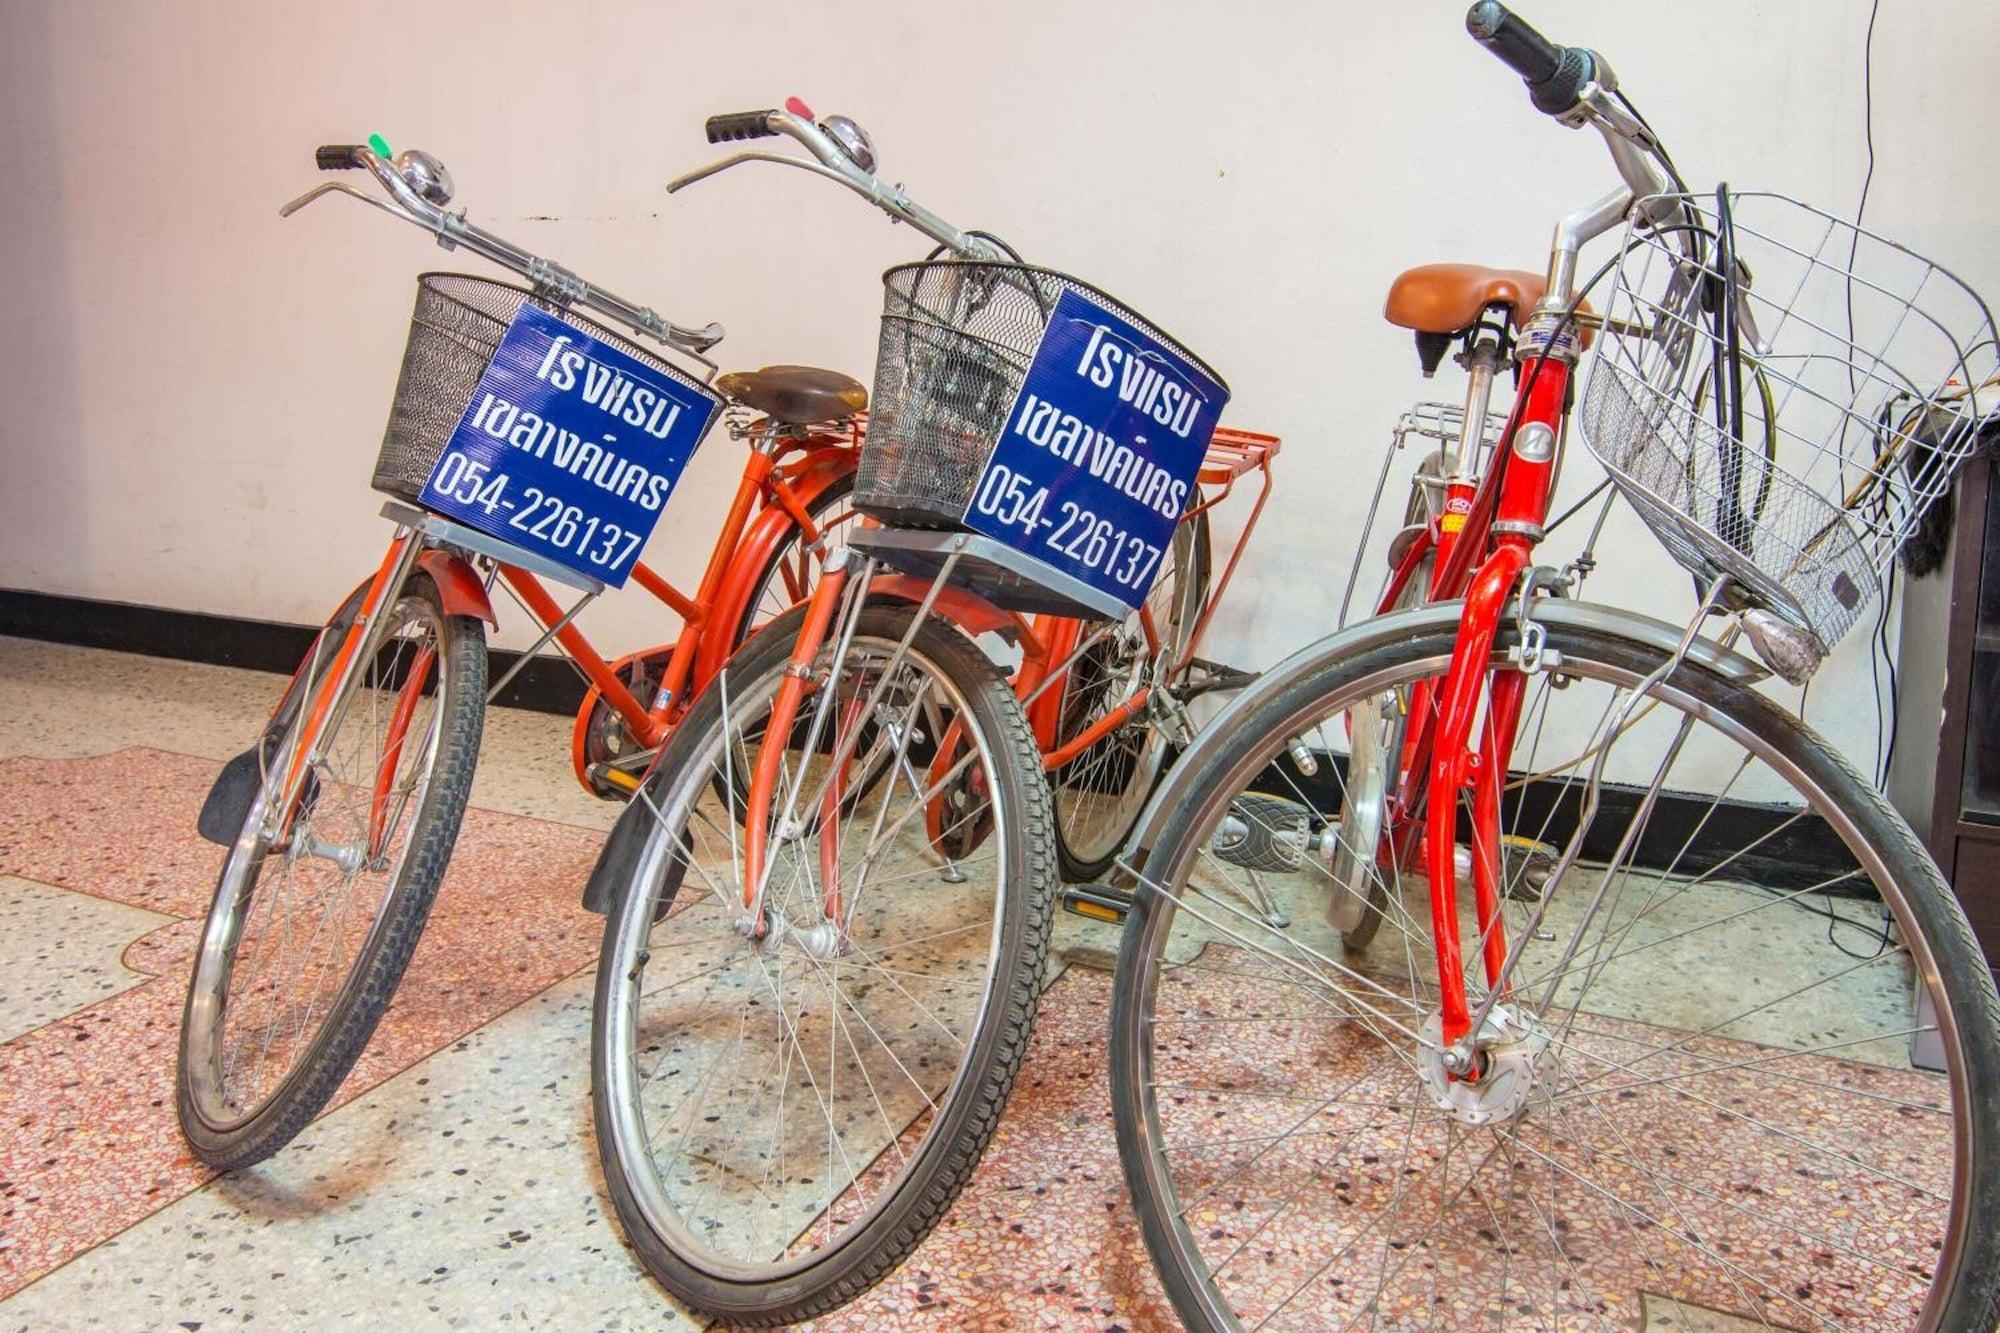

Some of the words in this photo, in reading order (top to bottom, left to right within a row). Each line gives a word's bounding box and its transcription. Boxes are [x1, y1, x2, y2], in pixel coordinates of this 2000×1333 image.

[537, 335, 681, 440] โรงแรม
[1076, 325, 1203, 439] โรงแรม
[433, 452, 642, 571] 054-226137
[977, 465, 1161, 591] 054-226137
